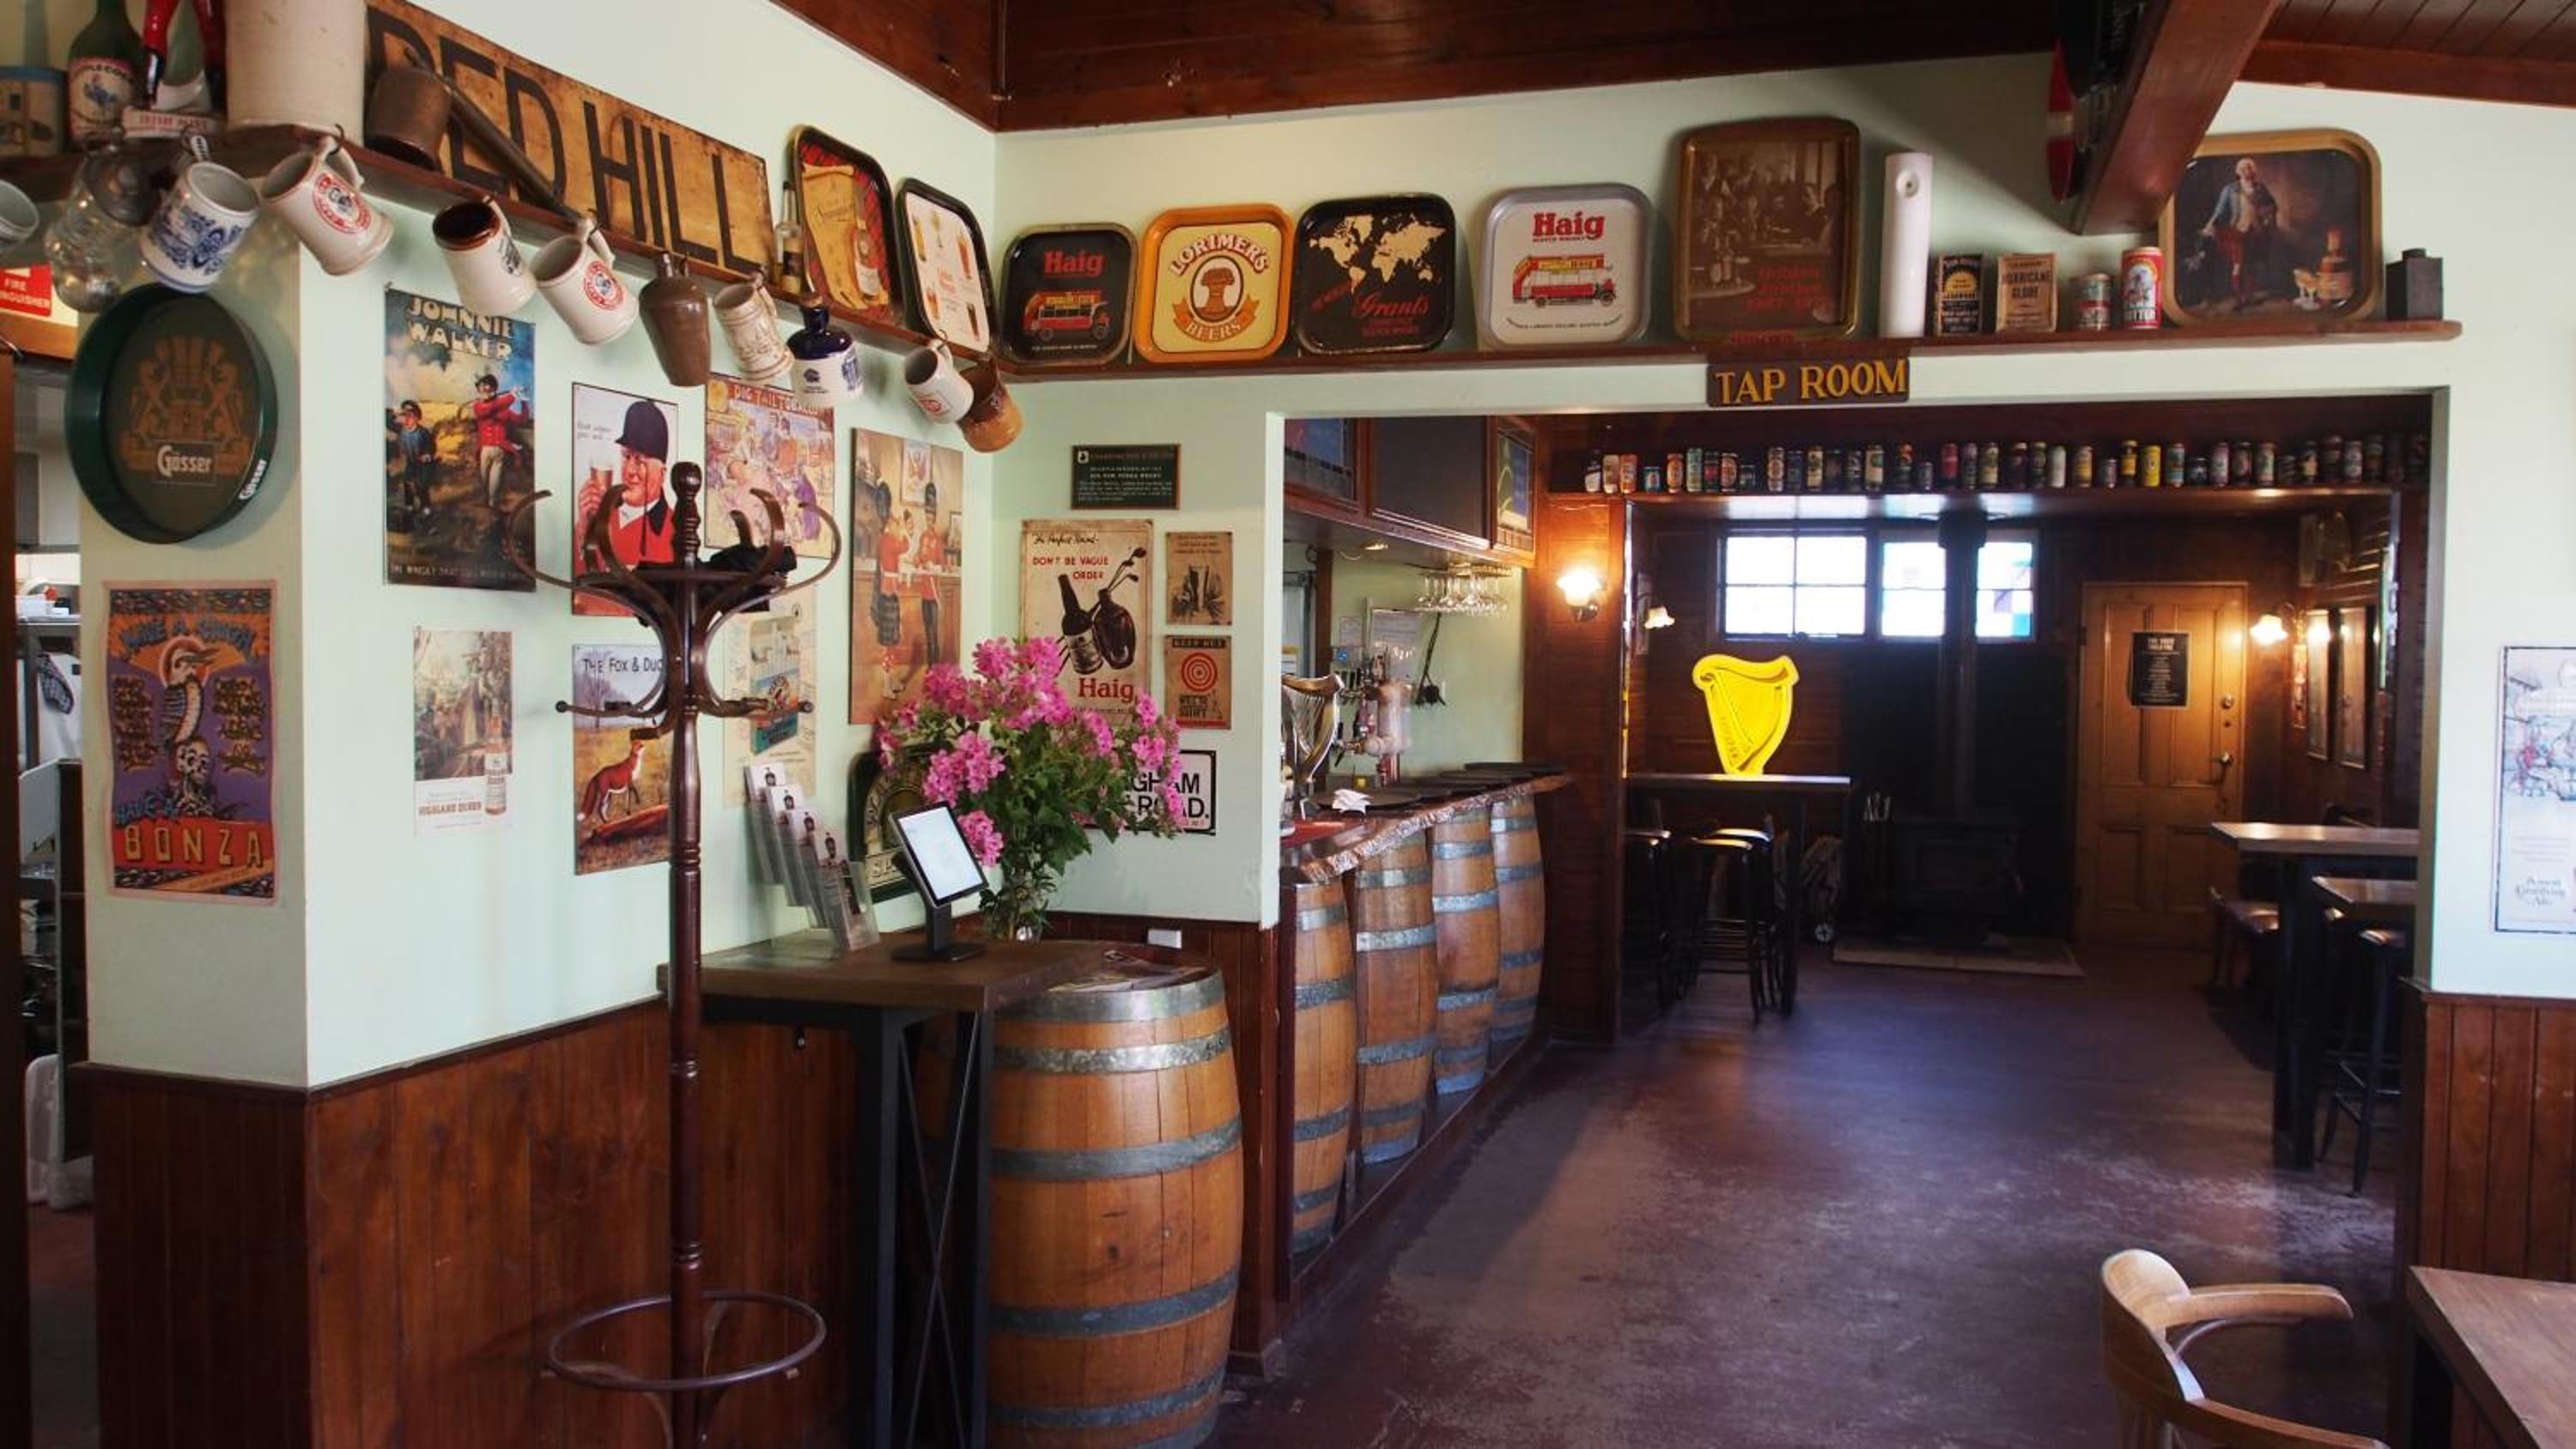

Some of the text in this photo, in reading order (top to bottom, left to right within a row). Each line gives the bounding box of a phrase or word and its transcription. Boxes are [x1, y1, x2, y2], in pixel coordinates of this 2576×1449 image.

[1532, 210, 1606, 240] Haig
[1044, 249, 1104, 277] Haig
[1170, 233, 1271, 276] LORIMER'S
[409, 295, 513, 338] JOHNNIE
[407, 321, 513, 362] WALKER
[1185, 322, 1241, 342] BEERS
[1715, 359, 1908, 406] TAP ROOM
[1032, 555, 1109, 566] DON'T BE VAGUE
[1072, 571, 1104, 579] ORDER
[584, 658, 604, 674] THE
[632, 657, 640, 672] &
[1078, 677, 1135, 704] Haig
[125, 825, 264, 868] BONZA
